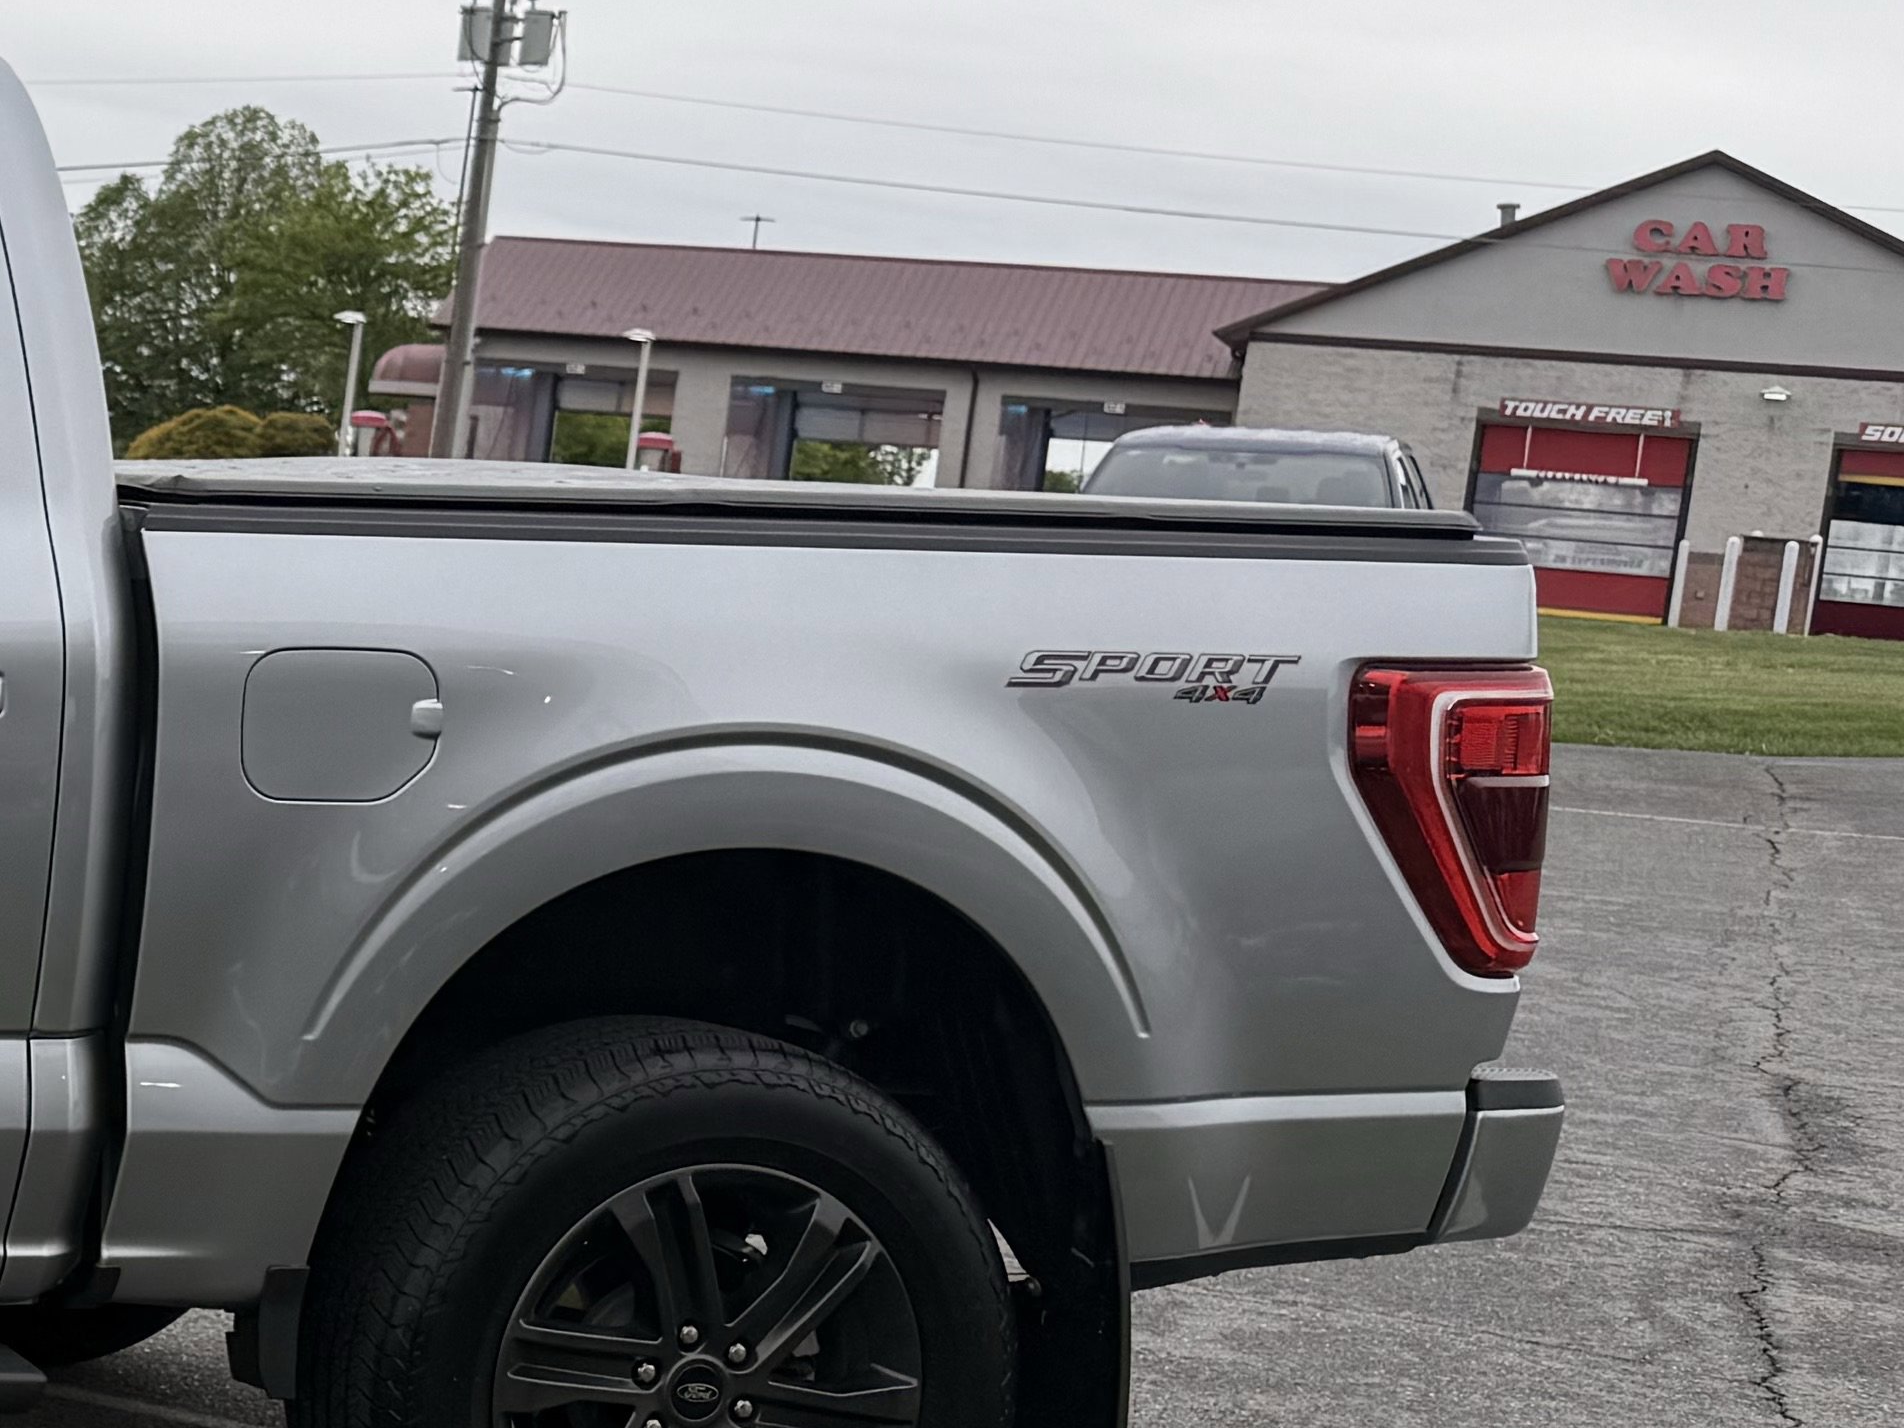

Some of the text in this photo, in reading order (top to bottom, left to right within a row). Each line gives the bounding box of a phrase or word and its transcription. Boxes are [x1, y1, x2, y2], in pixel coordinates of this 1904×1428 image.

[1633, 219, 1768, 260] CAR
[1605, 257, 1790, 301] WASH
[1503, 400, 1587, 421] TOUCH
[1005, 650, 1303, 688] SPORT
